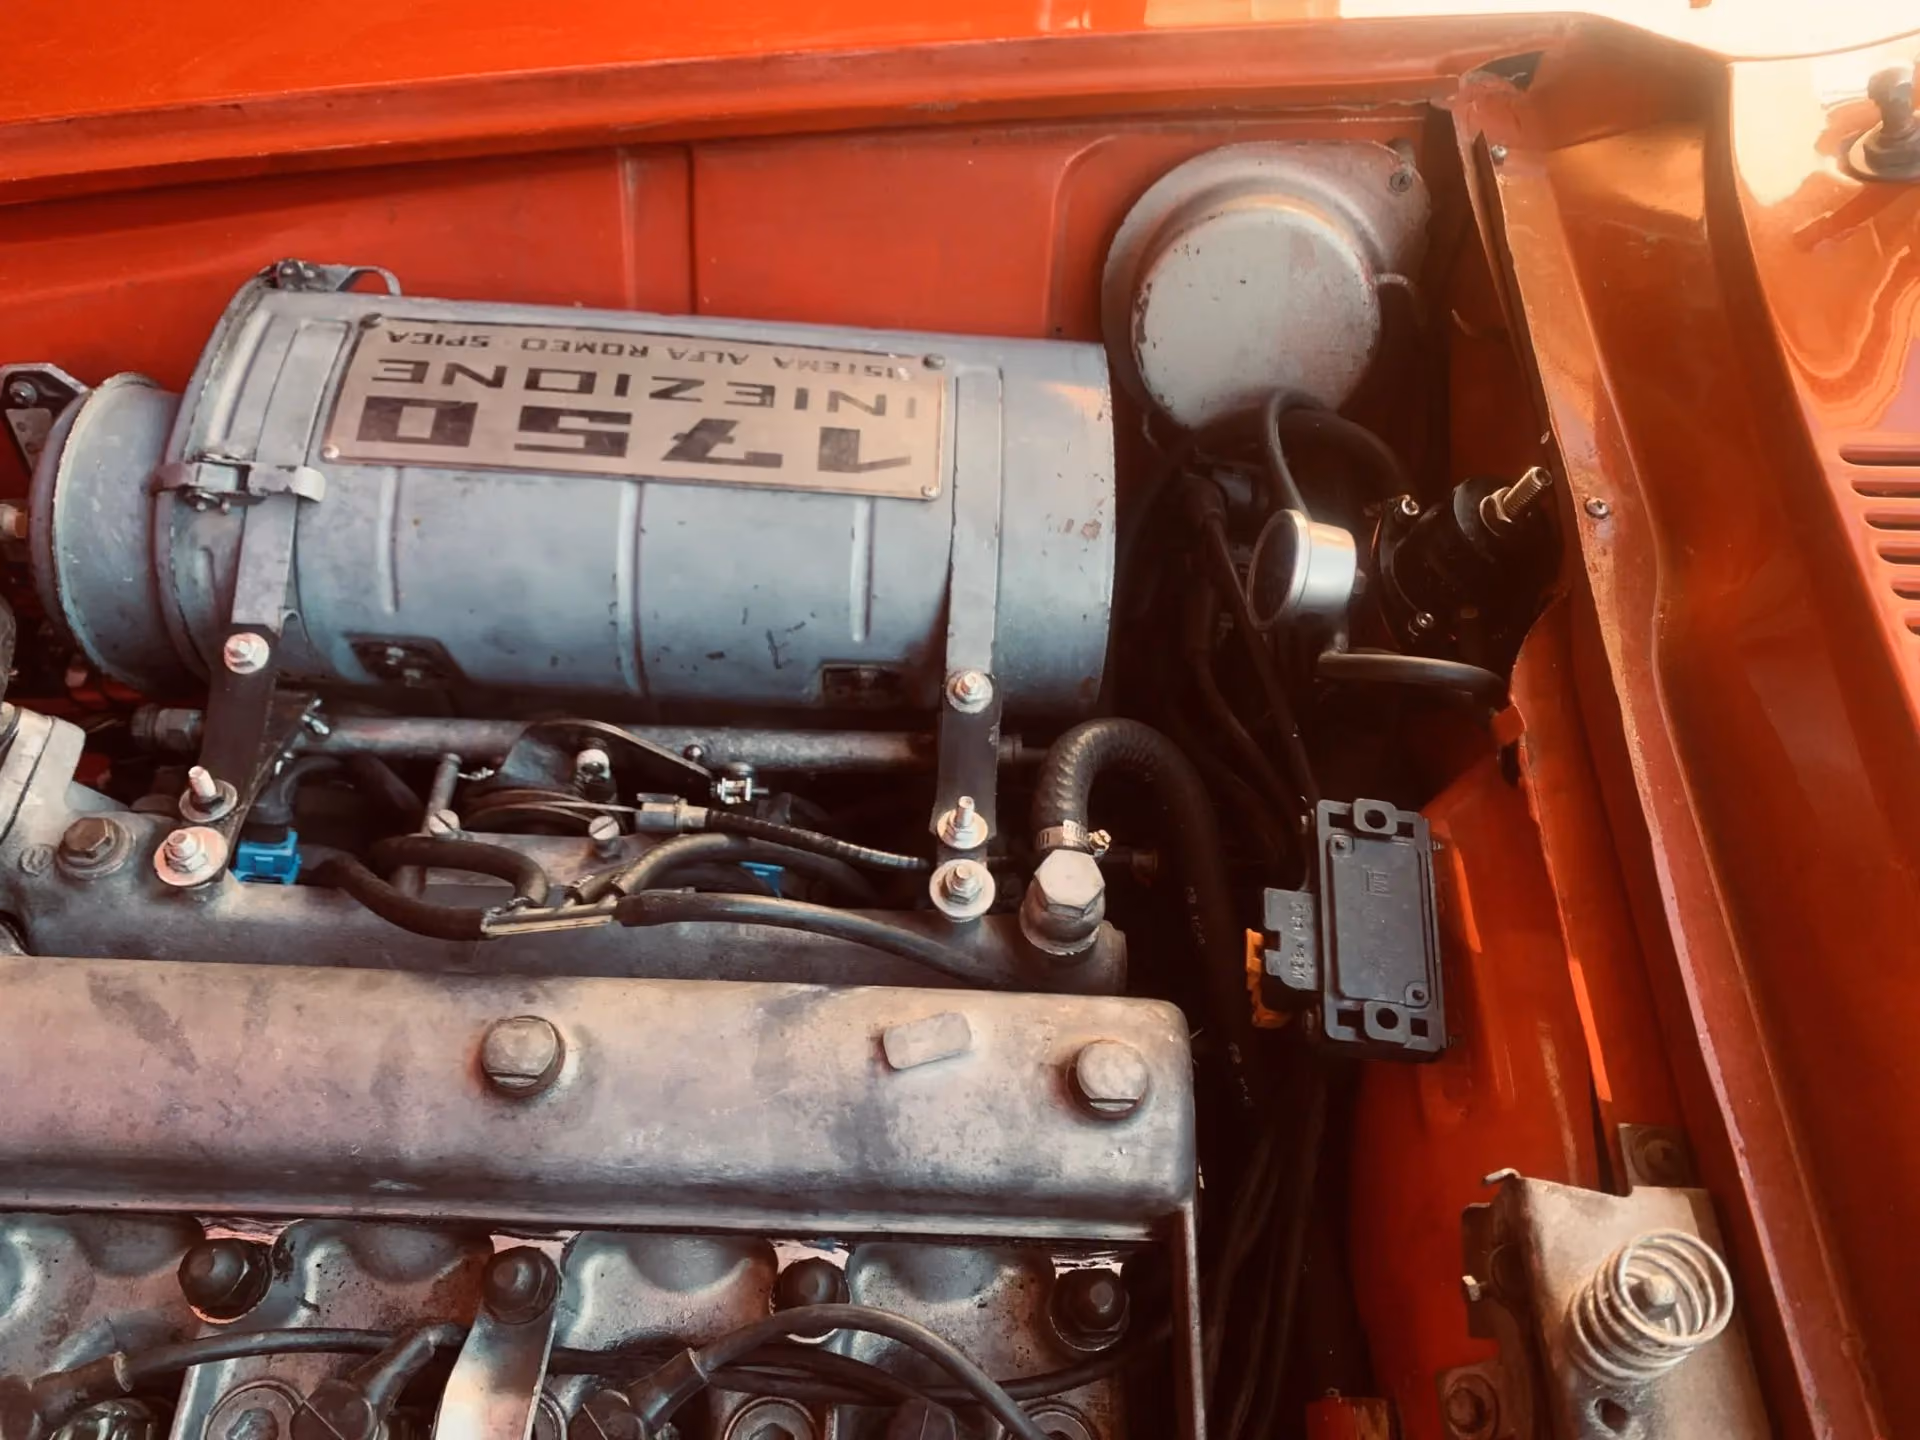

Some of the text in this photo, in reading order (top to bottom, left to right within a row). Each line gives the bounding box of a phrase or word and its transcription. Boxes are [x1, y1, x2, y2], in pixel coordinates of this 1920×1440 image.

[387, 331, 491, 347] SPICA
[521, 338, 649, 358] ROMEO
[667, 347, 749, 365] ALFA
[372, 359, 917, 419] INIEZIONE
[356, 396, 911, 474] 1750
